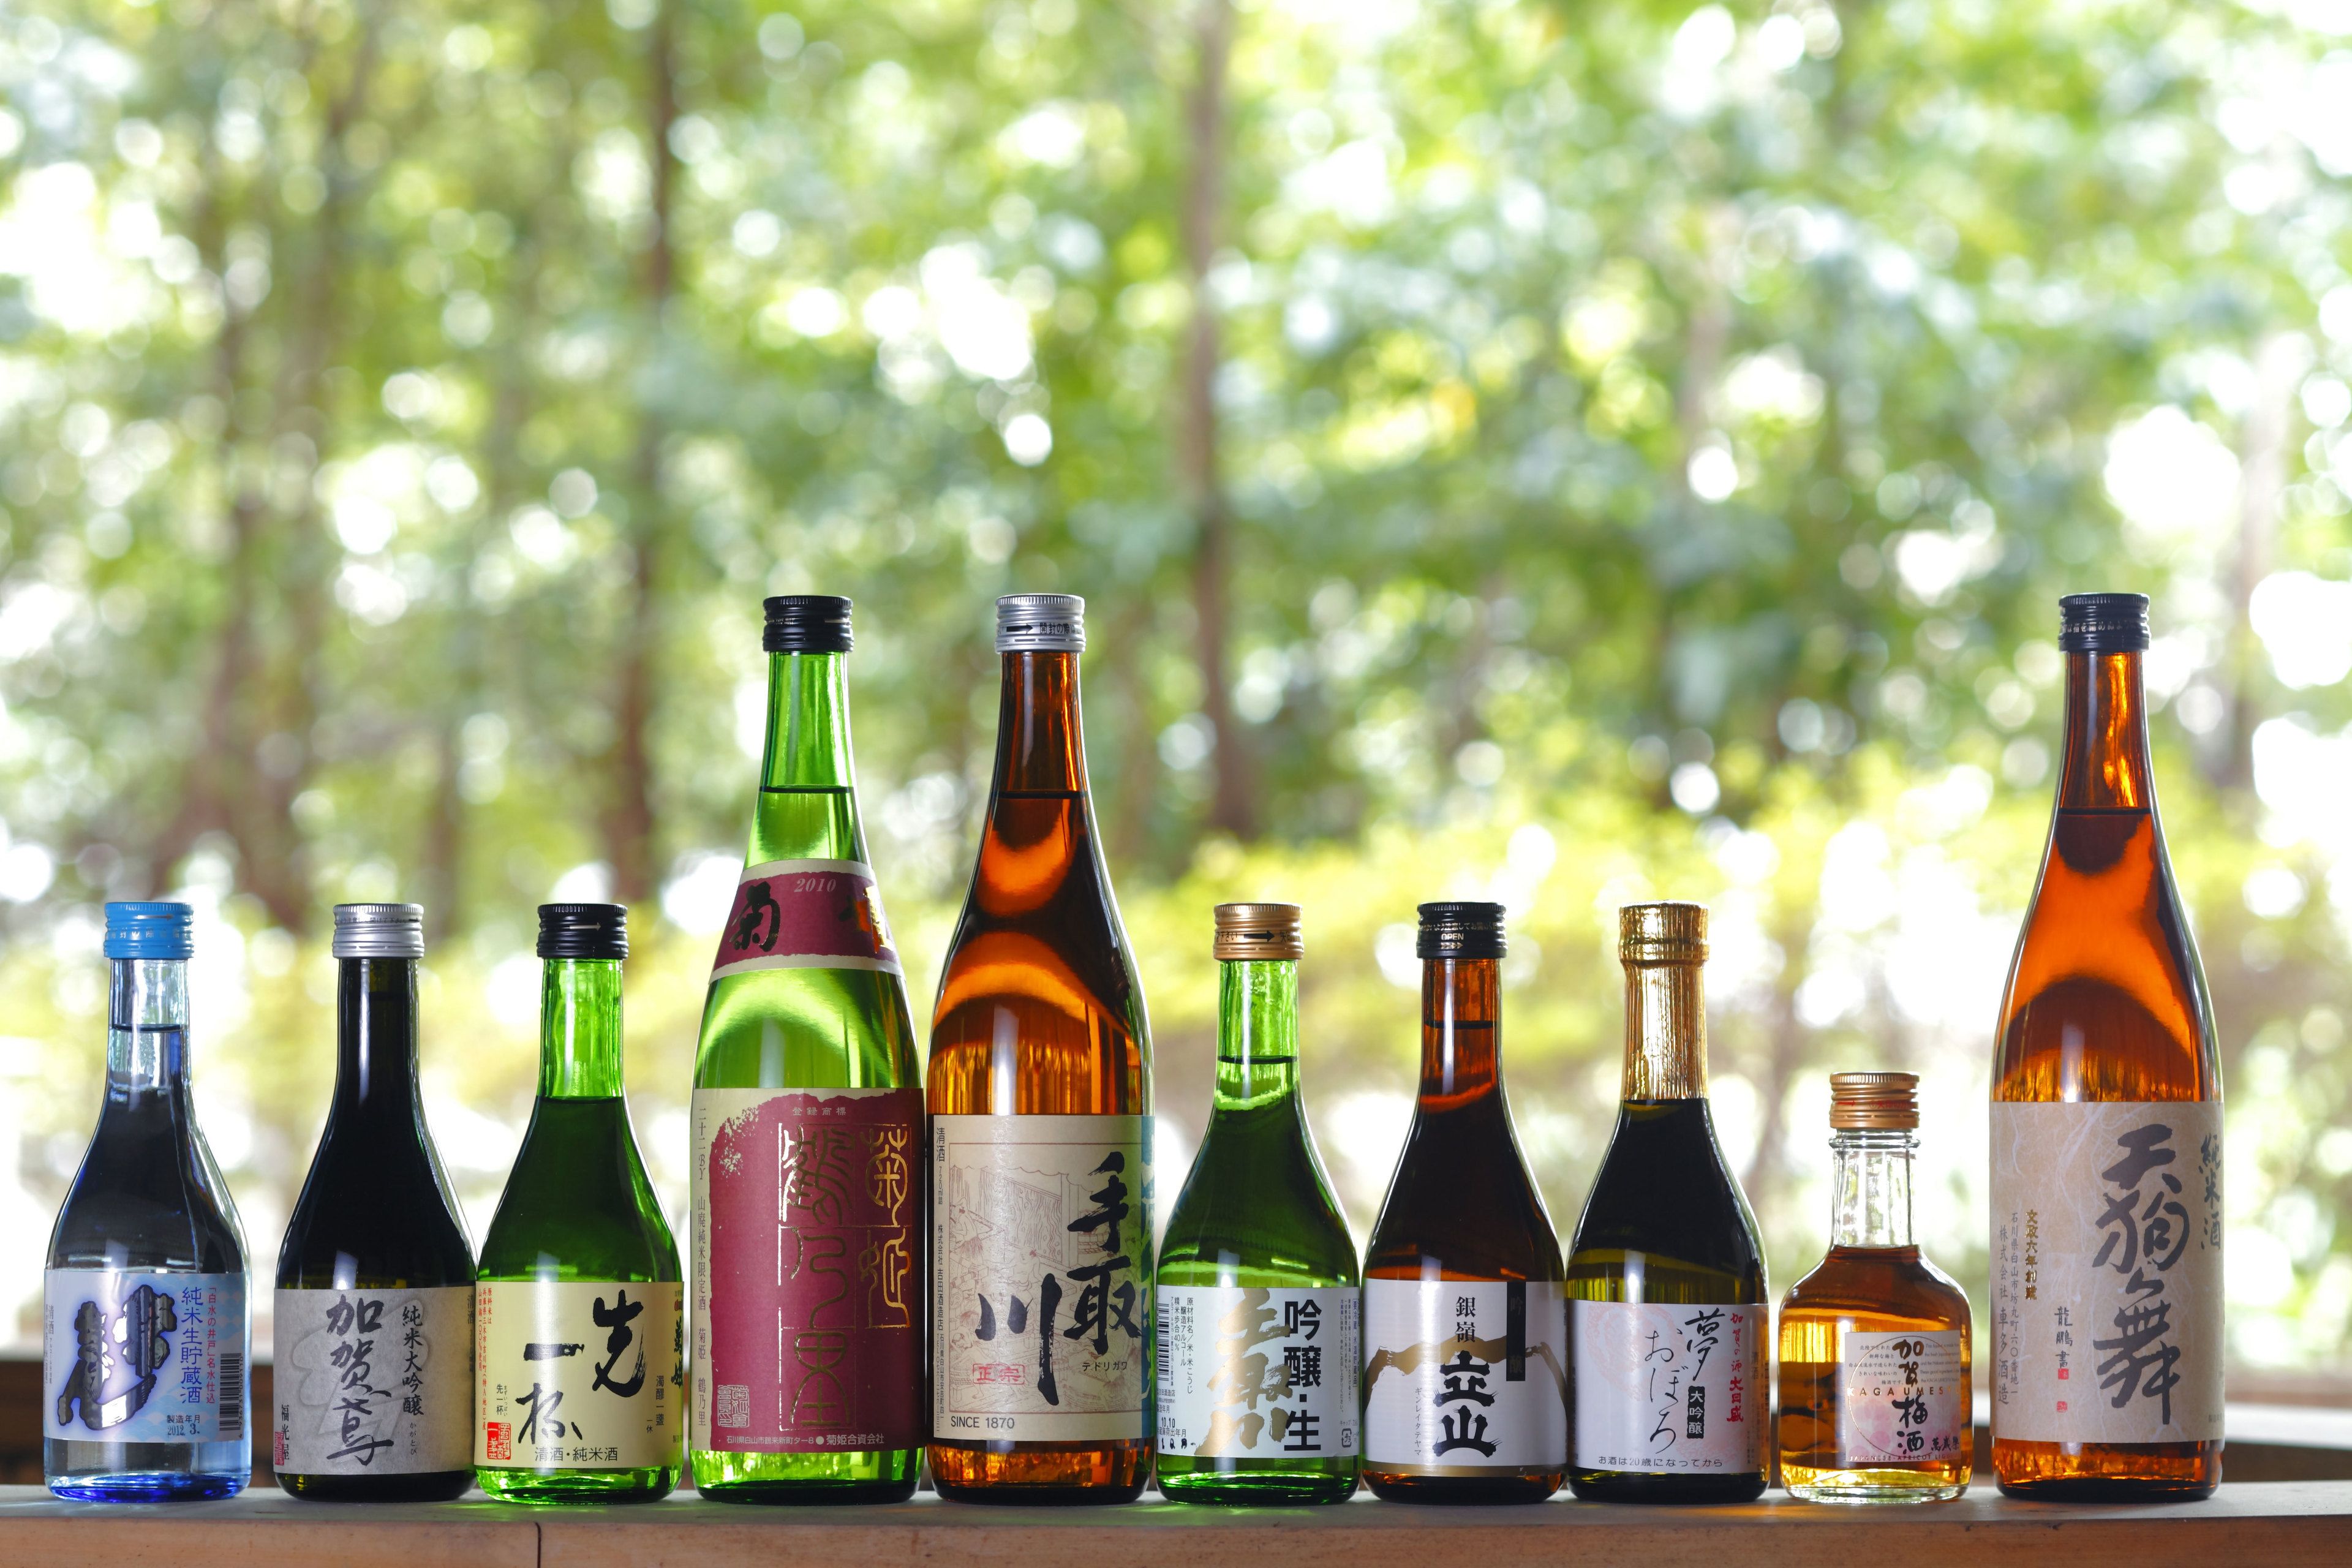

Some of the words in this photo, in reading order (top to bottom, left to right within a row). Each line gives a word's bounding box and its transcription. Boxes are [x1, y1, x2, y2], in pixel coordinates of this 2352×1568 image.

[794, 877, 837, 893] 2010
[792, 1106, 848, 1116] 登録商標
[936, 1127, 945, 1162] 清酒
[2198, 1134, 2222, 1251] 純米酒
[697, 1196, 707, 1311] 山廃純米限定酒
[1999, 1224, 2008, 1298] 株式会社
[2092, 1123, 2190, 1425] 天狗舞
[697, 1327, 707, 1359] 菊姫
[1455, 1296, 1476, 1343] 銀嶺
[1730, 1313, 1744, 1373] 加賀の酒
[181, 1286, 203, 1404] 純米生貯蔵酒
[206, 1286, 217, 1404] 「白水の井戸」名水仕込
[402, 1305, 424, 1416] 純米大吟醸
[1082, 1361, 1128, 1372] テドリガワ
[1684, 1308, 1725, 1382] 夢
[1998, 1306, 2010, 1405] 車多酒造
[976, 1365, 1023, 1384] 正宗
[1283, 1299, 1322, 1452] 吟醸・生
[1645, 1328, 1688, 1454] おぼろ
[167, 1414, 200, 1423] 製造年月
[697, 1377, 707, 1427] 鶴乃里
[951, 1416, 980, 1429] SINCE
[985, 1417, 1015, 1430] 1870
[1432, 1350, 1499, 1458] 立山
[1689, 1390, 1703, 1434] 大吟醸
[534, 1446, 618, 1463] 清酒・純米酒
[826, 1433, 885, 1446] 菊姫合資会社
[1598, 1456, 1723, 1468] お酒は20歳になってから
